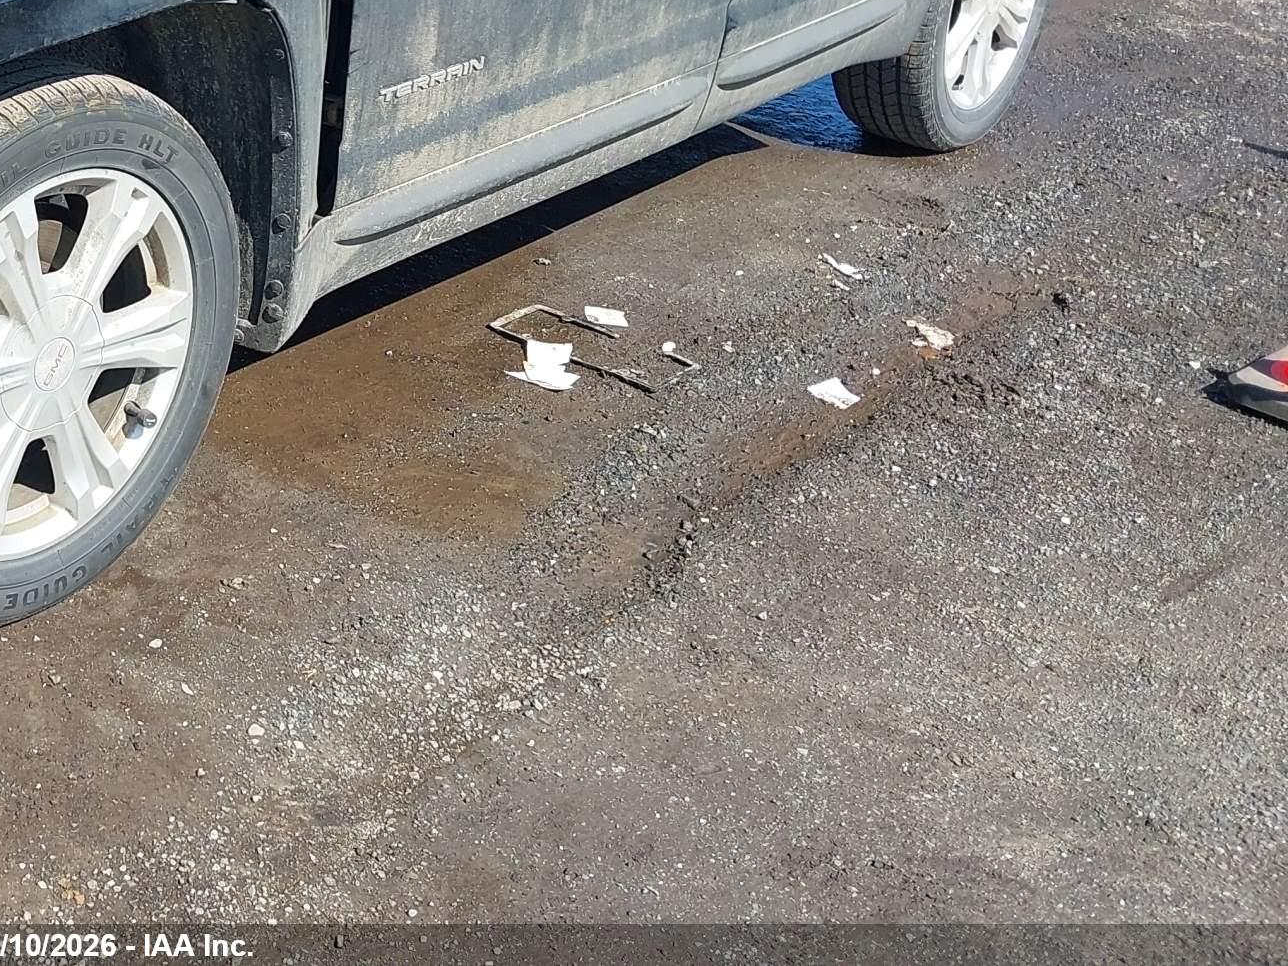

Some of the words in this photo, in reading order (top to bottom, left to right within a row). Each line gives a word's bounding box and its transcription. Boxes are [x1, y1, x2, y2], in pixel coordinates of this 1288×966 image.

[378, 55, 485, 102] TERRAIN
[44, 128, 127, 160] GUIDE
[137, 130, 180, 164] HLT
[43, 344, 67, 386] GMC
[3, 565, 88, 610] GUIDE
